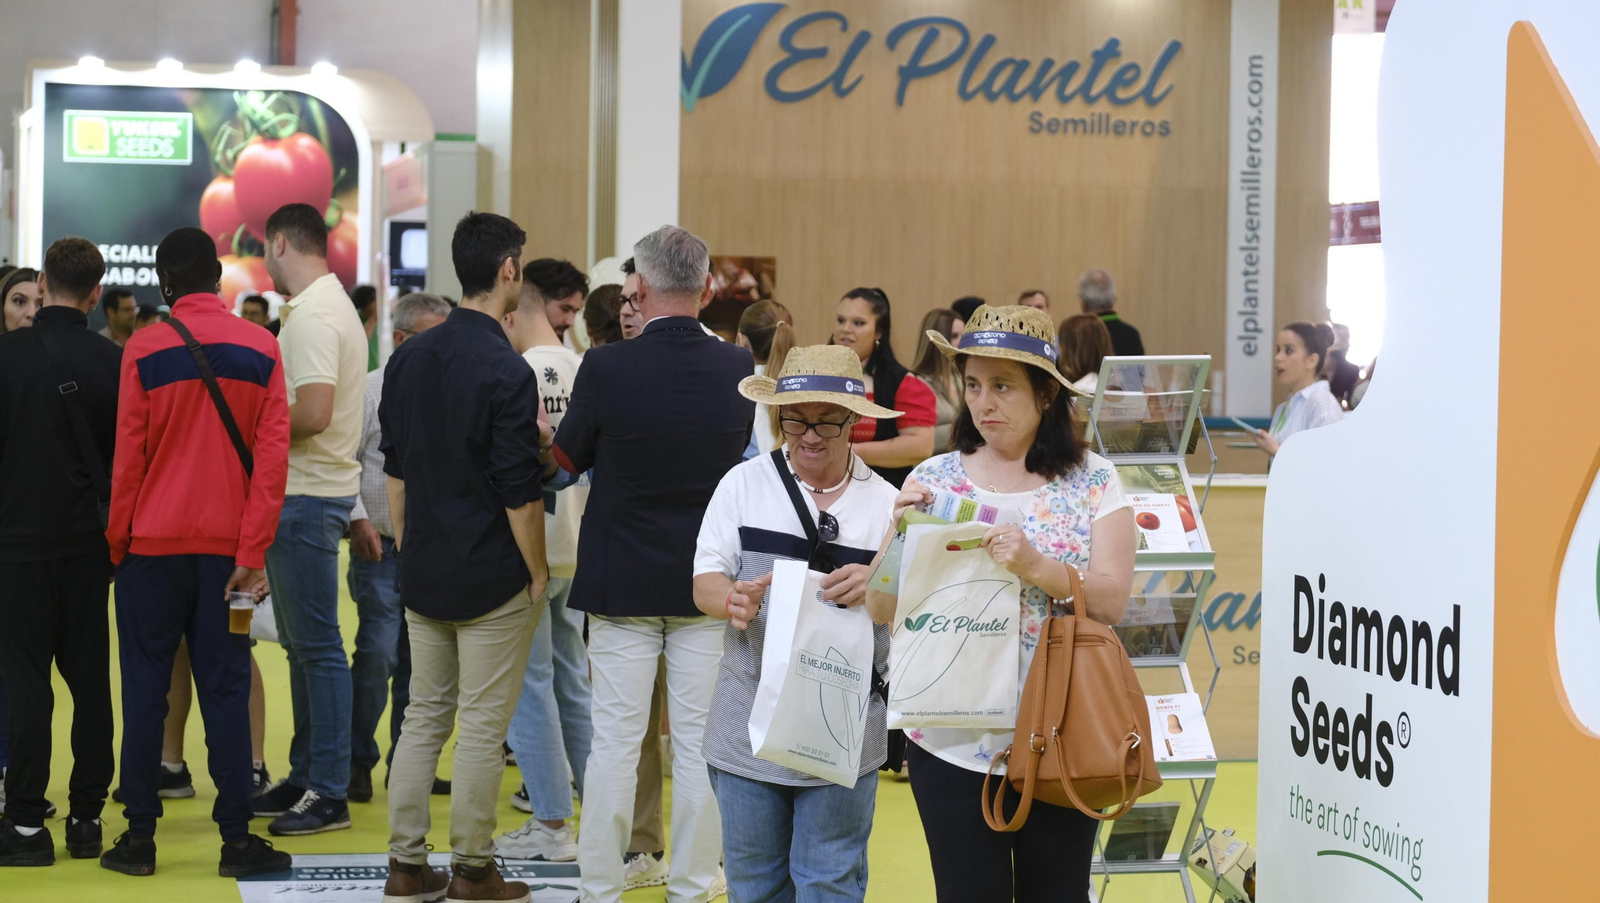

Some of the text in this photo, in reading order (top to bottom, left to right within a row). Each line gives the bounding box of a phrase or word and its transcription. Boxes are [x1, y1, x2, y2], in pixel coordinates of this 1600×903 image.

[763, 10, 1182, 107] El Plantel
[1028, 110, 1171, 137] Semilleros
[115, 136, 175, 158] SEEDS
[1237, 54, 1264, 357] elplantelsemilleros.com
[929, 615, 1009, 634] El Plantel
[1293, 572, 1461, 697] Diamond
[798, 663, 860, 690] PARA TU COSECHA
[799, 654, 861, 682] EL MEJOR INJERTO
[901, 709, 983, 717] www.elplantelsemilleros.com
[801, 745, 810, 753] 950
[1289, 784, 1424, 882] the art of sowing
